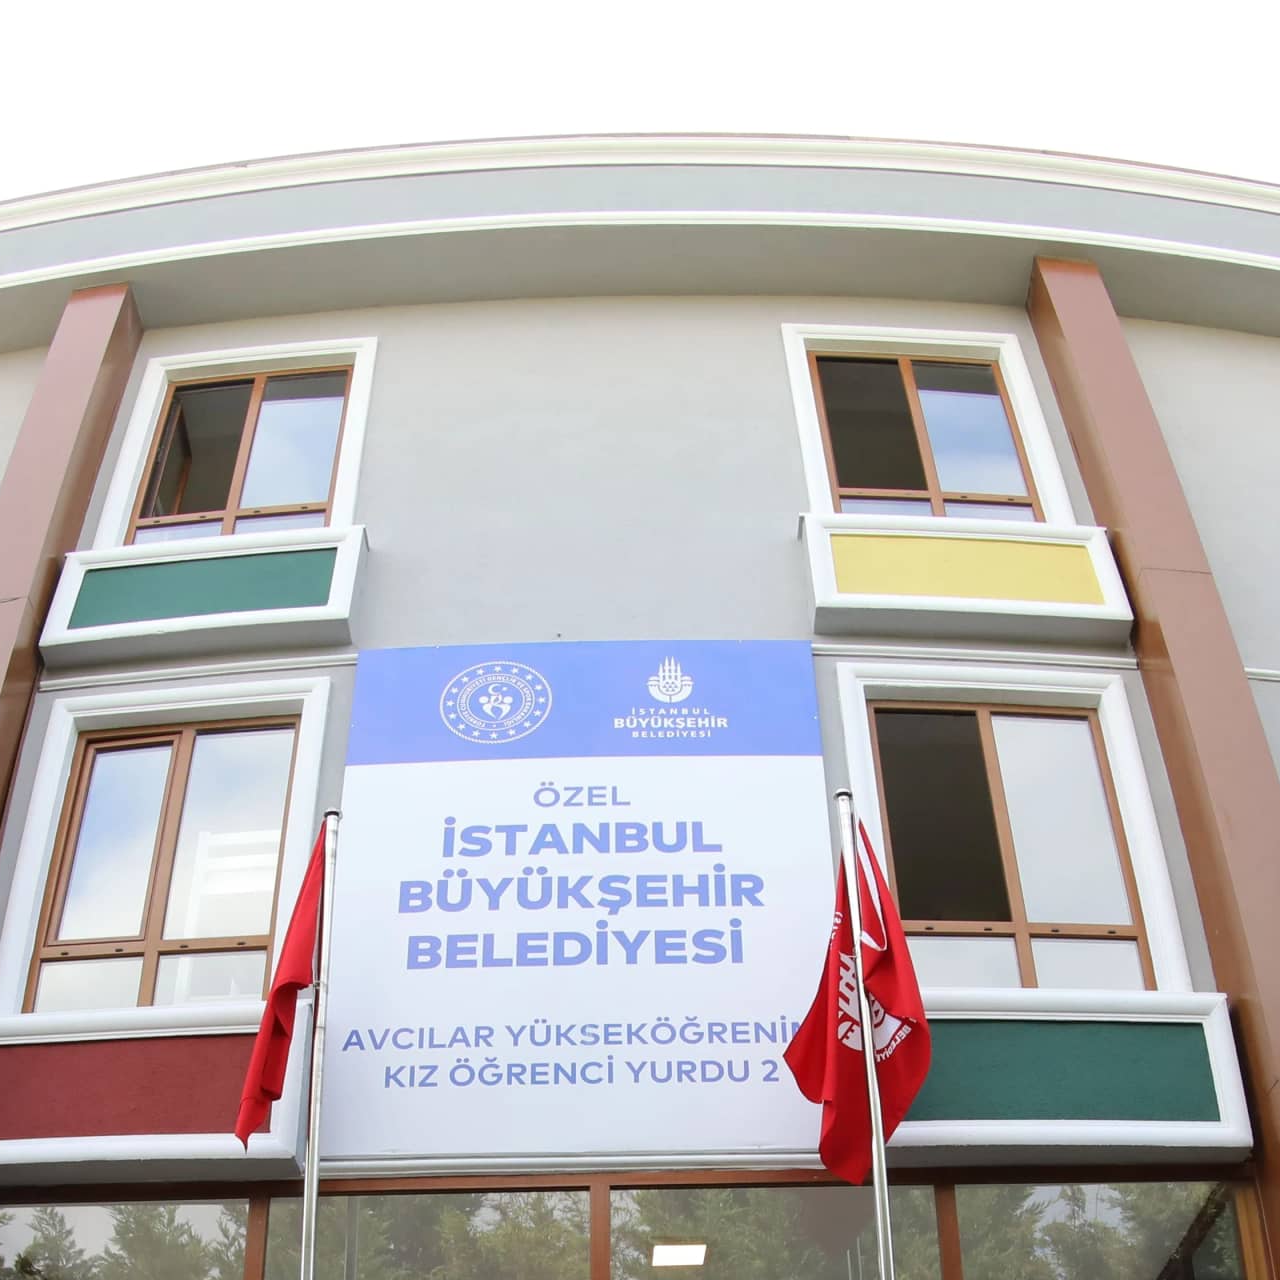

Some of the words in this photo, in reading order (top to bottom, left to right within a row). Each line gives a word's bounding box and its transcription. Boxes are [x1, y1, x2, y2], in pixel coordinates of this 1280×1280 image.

[613, 715, 728, 729] BÜYÜKŞEHİR
[631, 706, 711, 716] İSTANBUL
[631, 728, 712, 738] BELEDİYESİ
[533, 781, 631, 808] ÖZEL
[441, 815, 724, 859] İSTANBUL
[397, 862, 766, 917] BÜYÜKŞEHİR
[405, 917, 745, 971] BELEDİYESİ
[341, 1025, 496, 1052] AVCILAR
[383, 1063, 440, 1090] KIZ
[448, 1054, 616, 1088] ÖĞRENCİ
[624, 1059, 750, 1084] YURDU
[761, 1059, 780, 1083] 2
